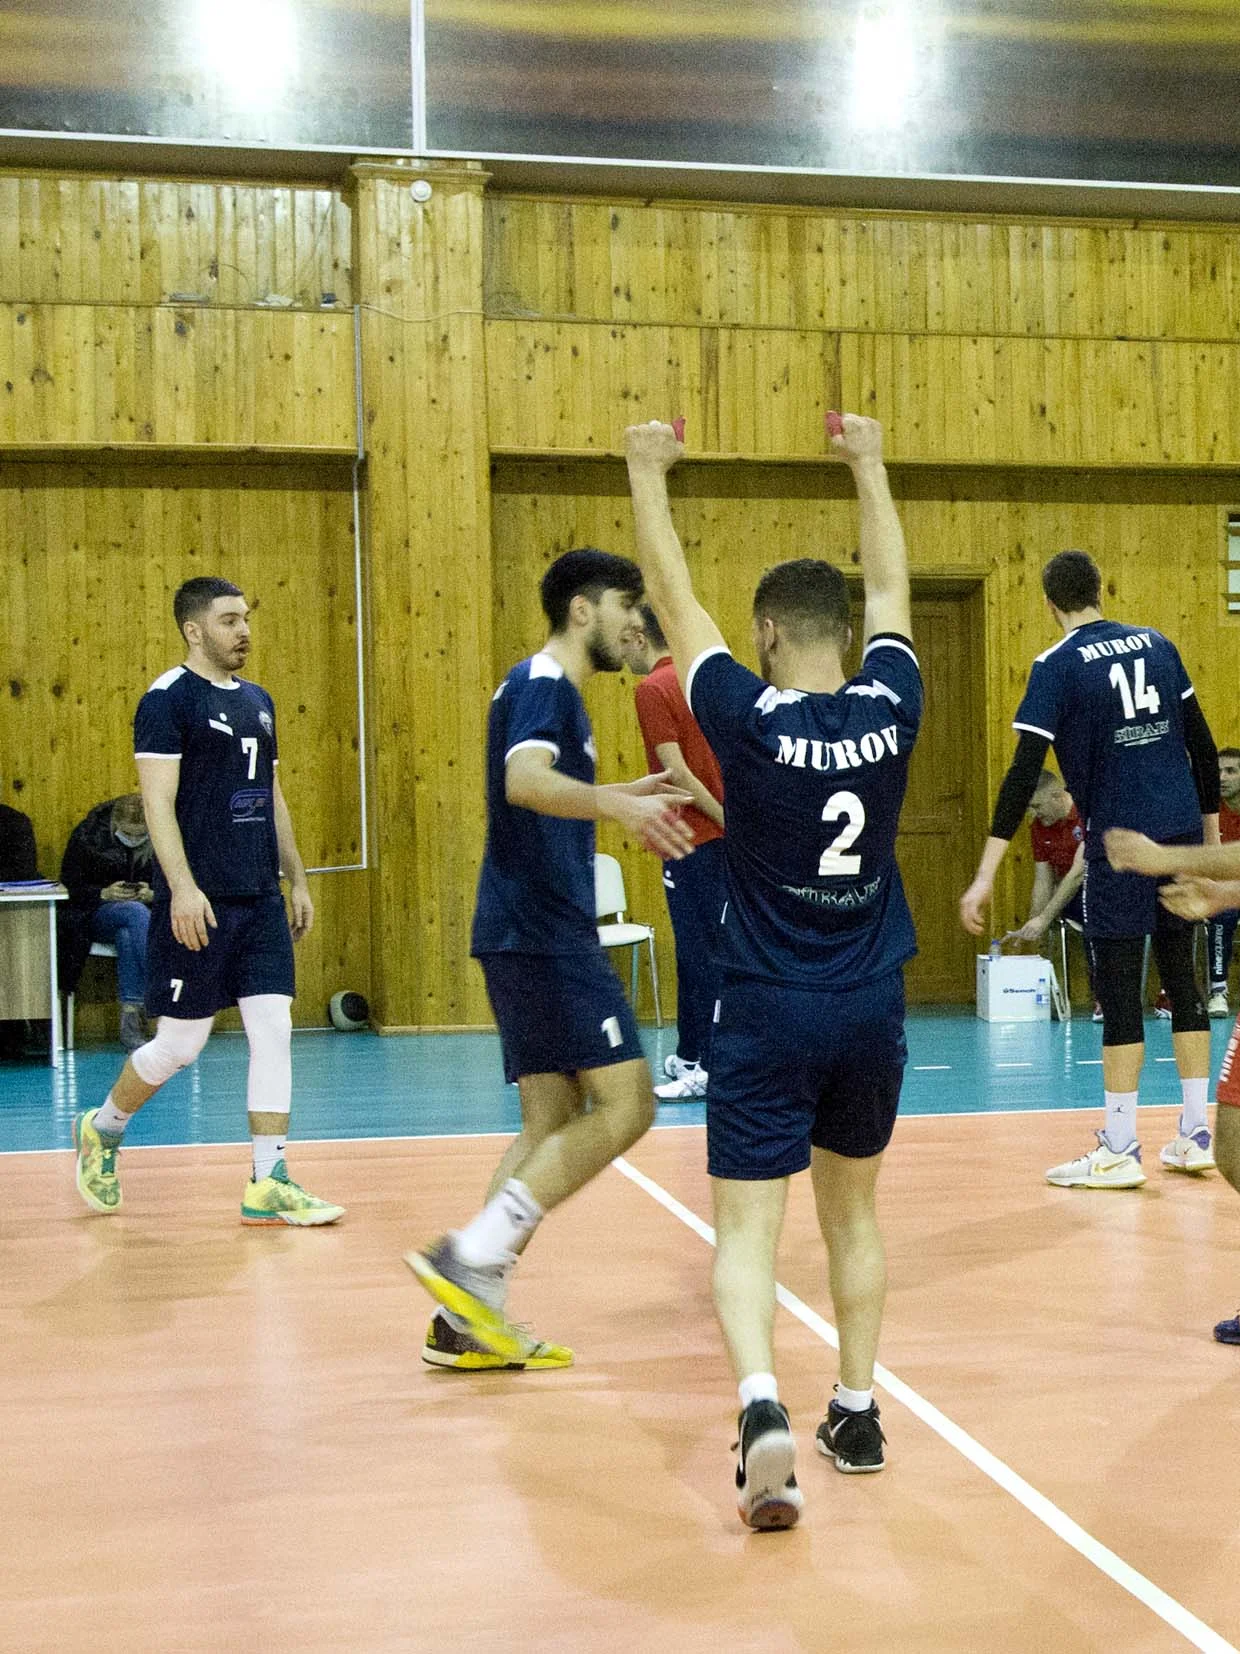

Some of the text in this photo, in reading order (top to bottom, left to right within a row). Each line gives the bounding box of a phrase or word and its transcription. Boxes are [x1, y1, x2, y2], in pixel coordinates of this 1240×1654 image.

[1077, 632, 1153, 663] MUROV
[1108, 657, 1161, 720] 14
[241, 737, 258, 780] 7
[774, 725, 899, 771] MUROV
[818, 790, 866, 876] 2
[170, 978, 183, 1002] 7
[601, 1016, 624, 1048] 1
